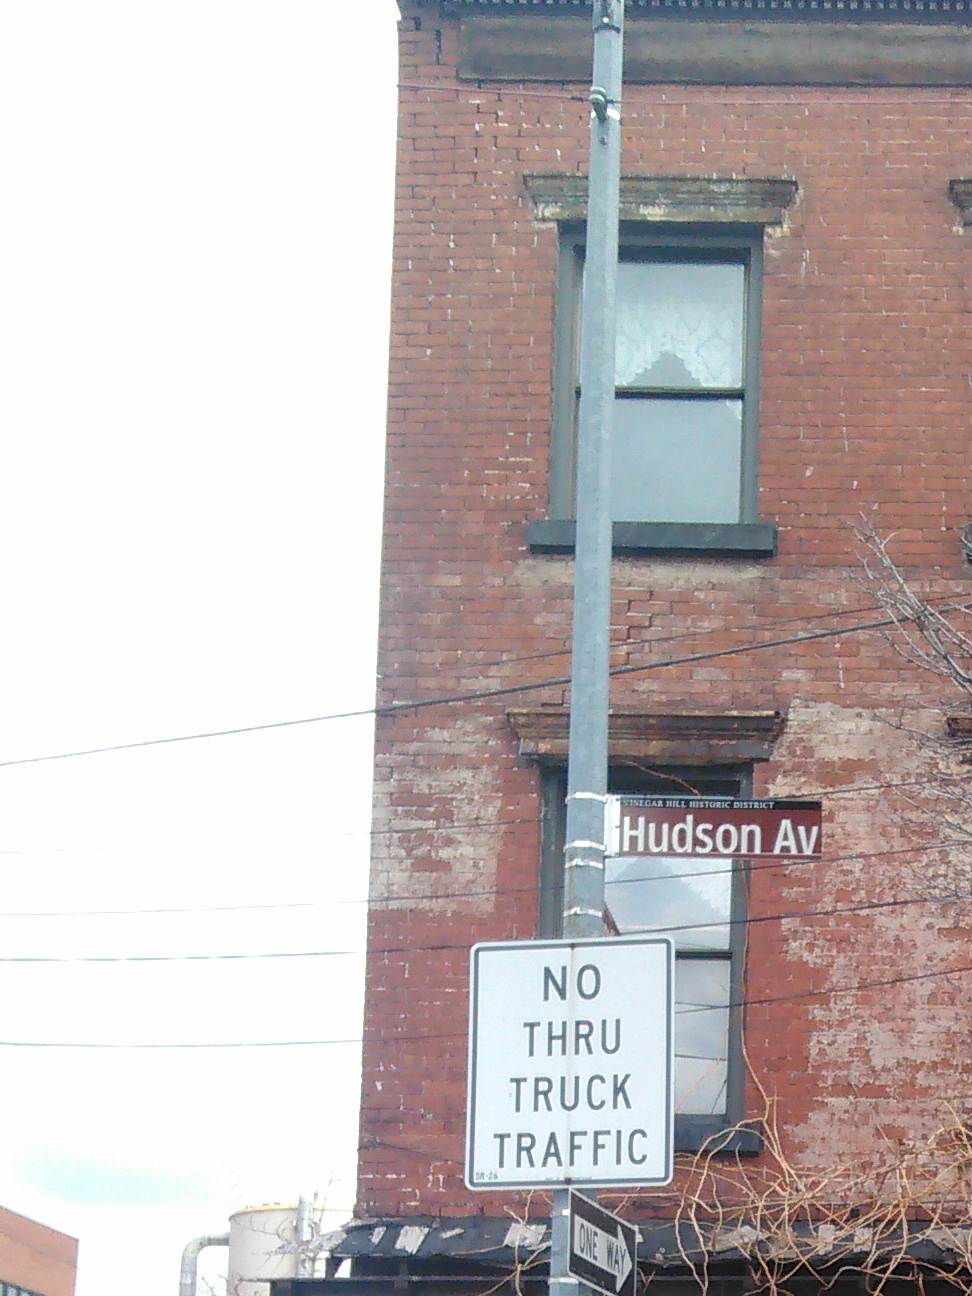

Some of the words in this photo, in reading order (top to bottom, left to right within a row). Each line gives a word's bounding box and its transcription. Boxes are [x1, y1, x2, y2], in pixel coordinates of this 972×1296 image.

[623, 799, 664, 808] VINEGAR
[666, 800, 686, 809] HILL
[689, 801, 731, 810] HISTORIC
[733, 801, 775, 810] DISTRICT
[622, 814, 762, 855] Hudson
[773, 818, 819, 855] Av
[542, 963, 601, 1002] NO
[522, 1018, 621, 1057] THRU
[509, 1073, 632, 1113] TRUCK
[493, 1128, 648, 1169] TRAFFIC
[579, 1222, 598, 1260] ONE
[606, 1239, 627, 1277] WAY
